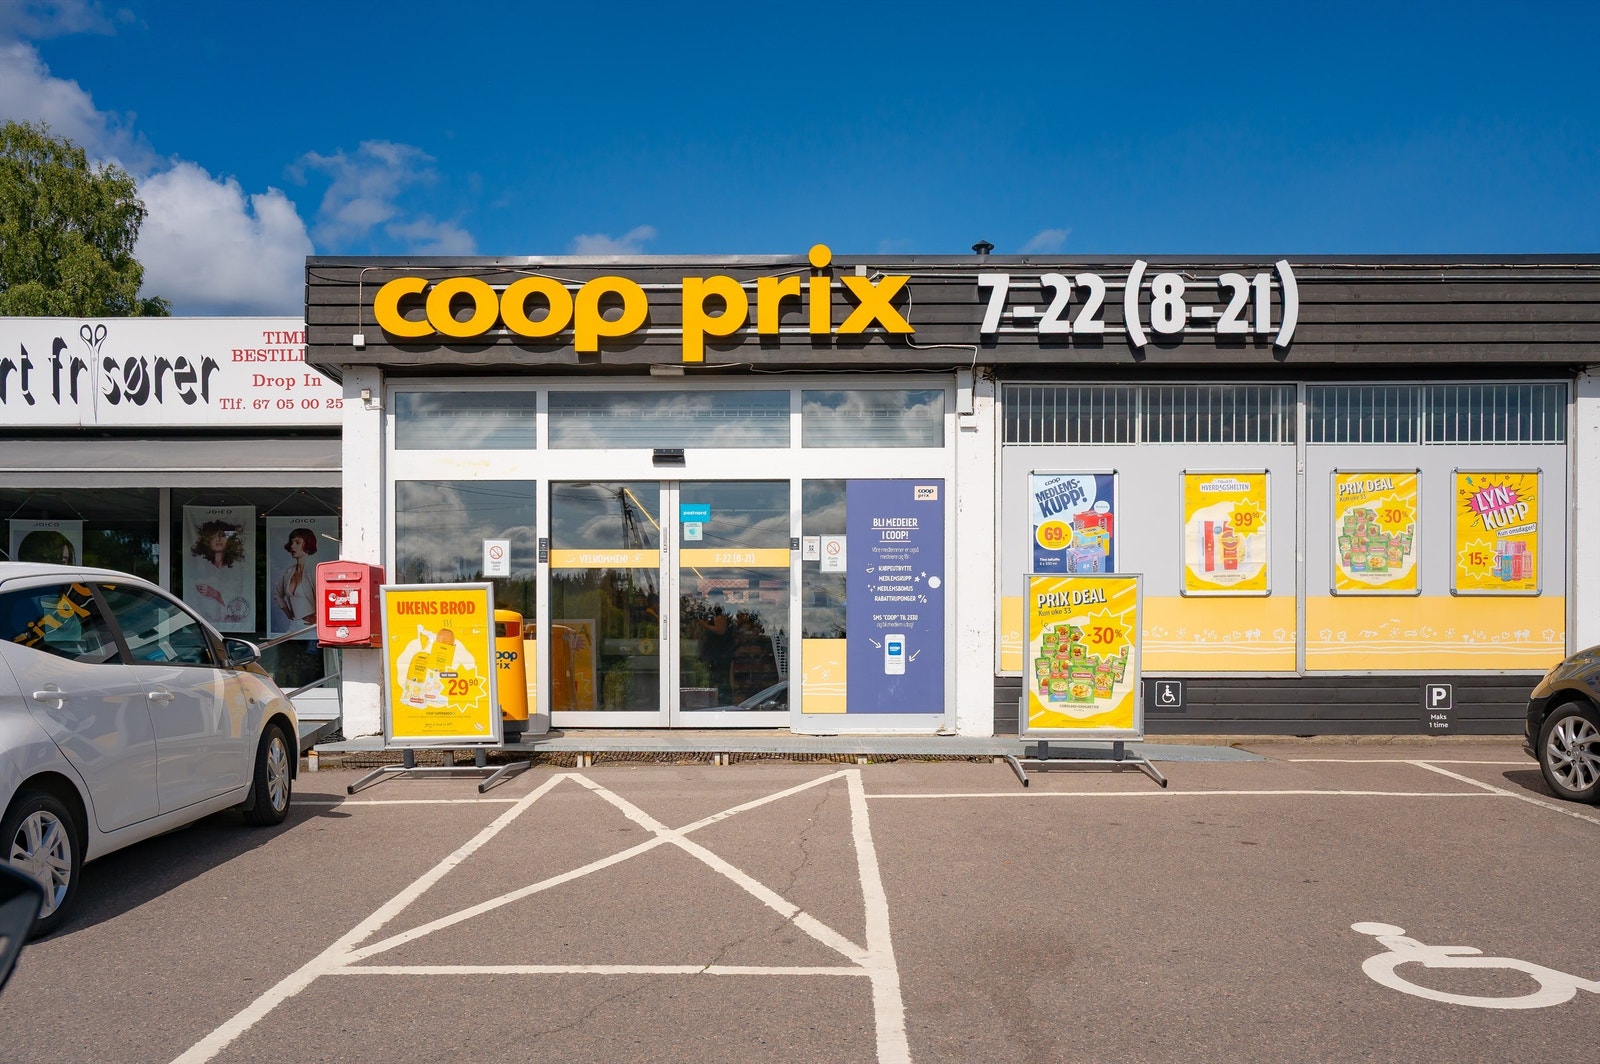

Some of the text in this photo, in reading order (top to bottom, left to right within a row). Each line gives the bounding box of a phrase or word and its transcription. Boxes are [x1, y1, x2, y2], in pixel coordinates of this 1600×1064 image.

[373, 243, 916, 362] coop prix
[978, 259, 1299, 347] 7-22 (8-21)
[252, 374, 322, 390] Drop In
[219, 398, 343, 410] Tlf. 67 05 00 25
[1045, 477, 1061, 486] coop
[1339, 478, 1395, 496] PRIX DEAL
[1035, 479, 1080, 503] MEDLEMS-
[1475, 486, 1515, 511] LYN-
[1039, 486, 1088, 518] KUPP!
[873, 518, 918, 527] BLI MEDEIER
[1481, 501, 1529, 531] KUPP
[885, 531, 909, 540] COOP!
[579, 553, 629, 564] VELKOMMEN!
[396, 600, 476, 615] UKENS BRØD
[1037, 588, 1107, 609] PRIX DEAL
[1432, 687, 1447, 706] P
